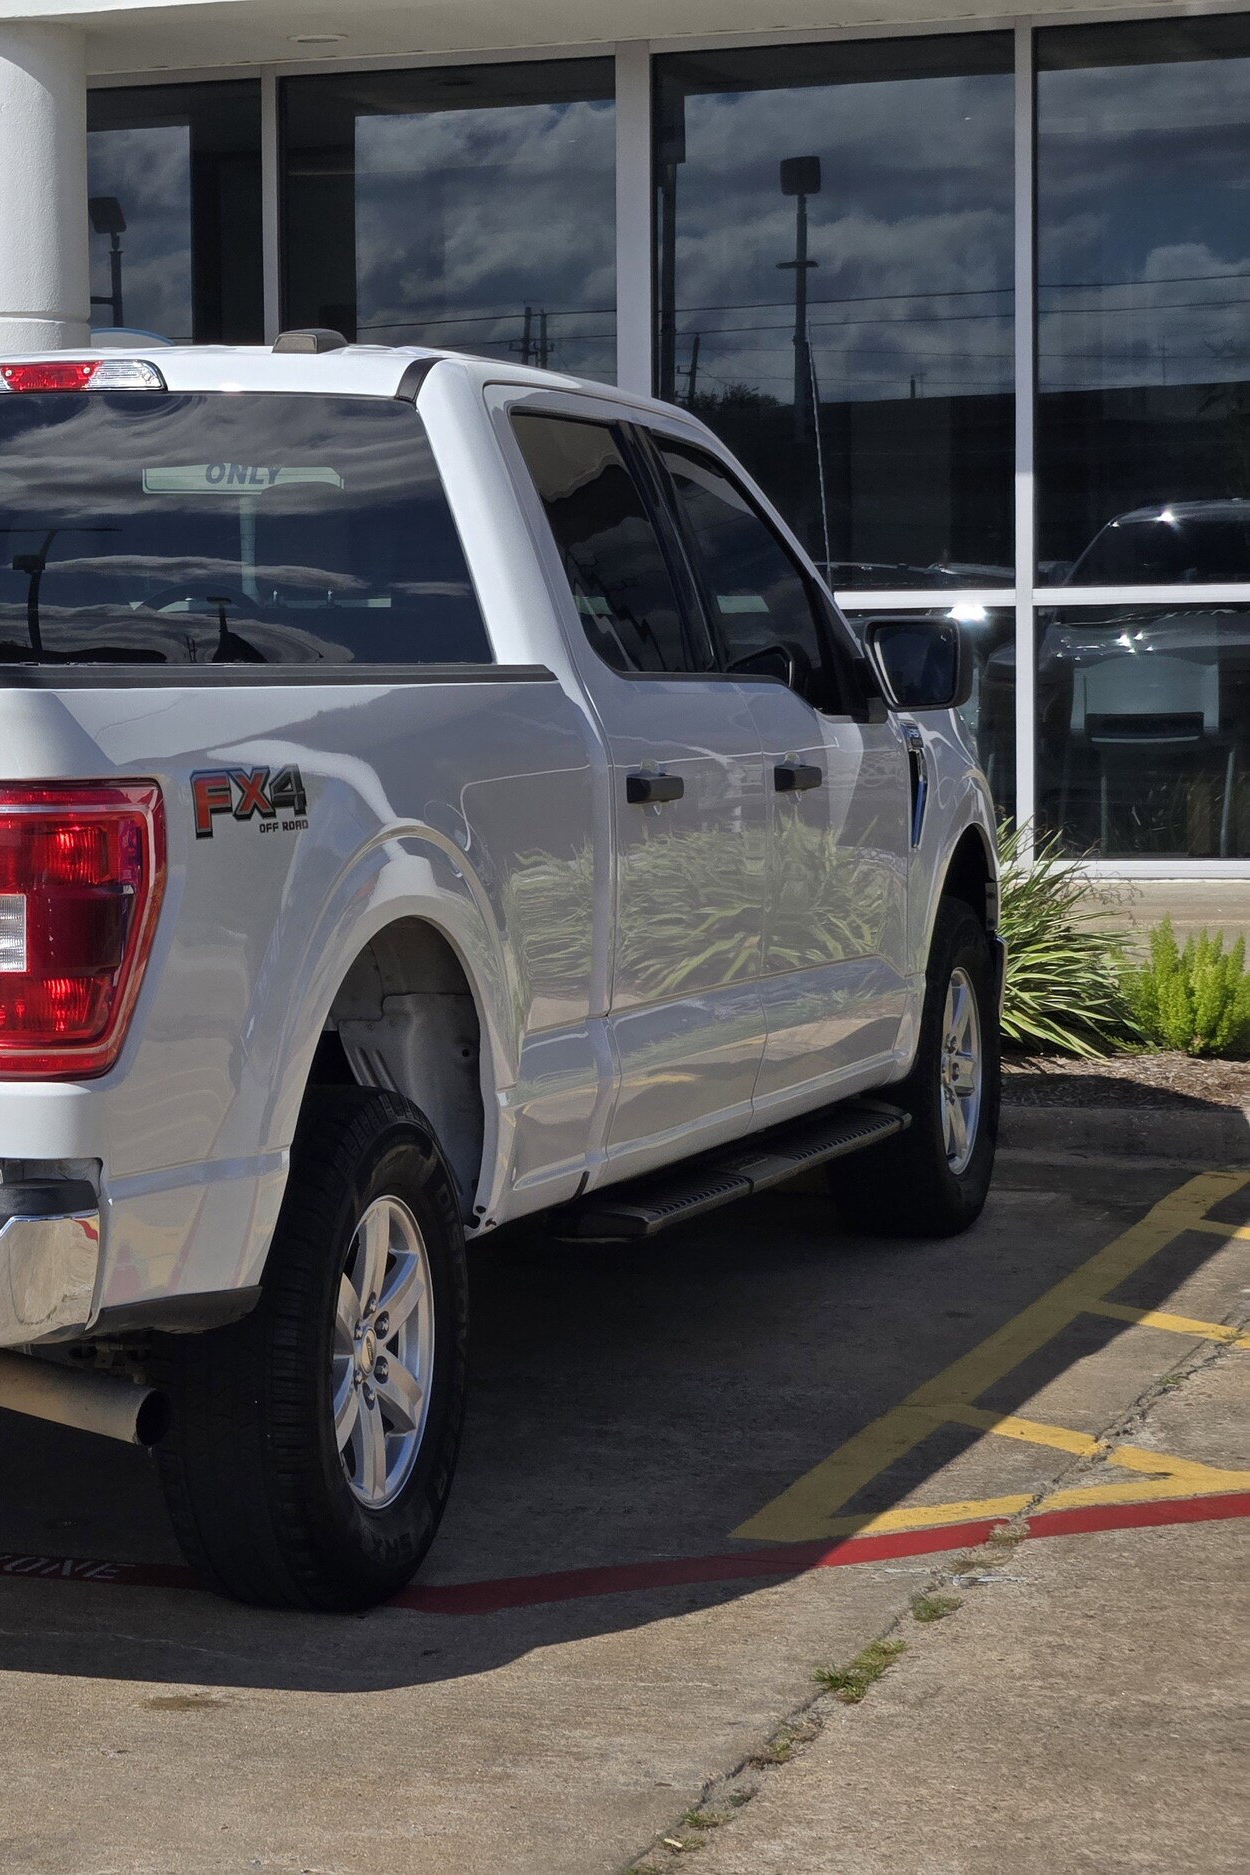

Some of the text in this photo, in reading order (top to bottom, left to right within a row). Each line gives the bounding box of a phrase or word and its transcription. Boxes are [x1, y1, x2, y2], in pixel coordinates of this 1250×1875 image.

[205, 463, 282, 485] ONLY
[190, 763, 307, 840] FX4
[259, 820, 309, 833] OFF ROAD
